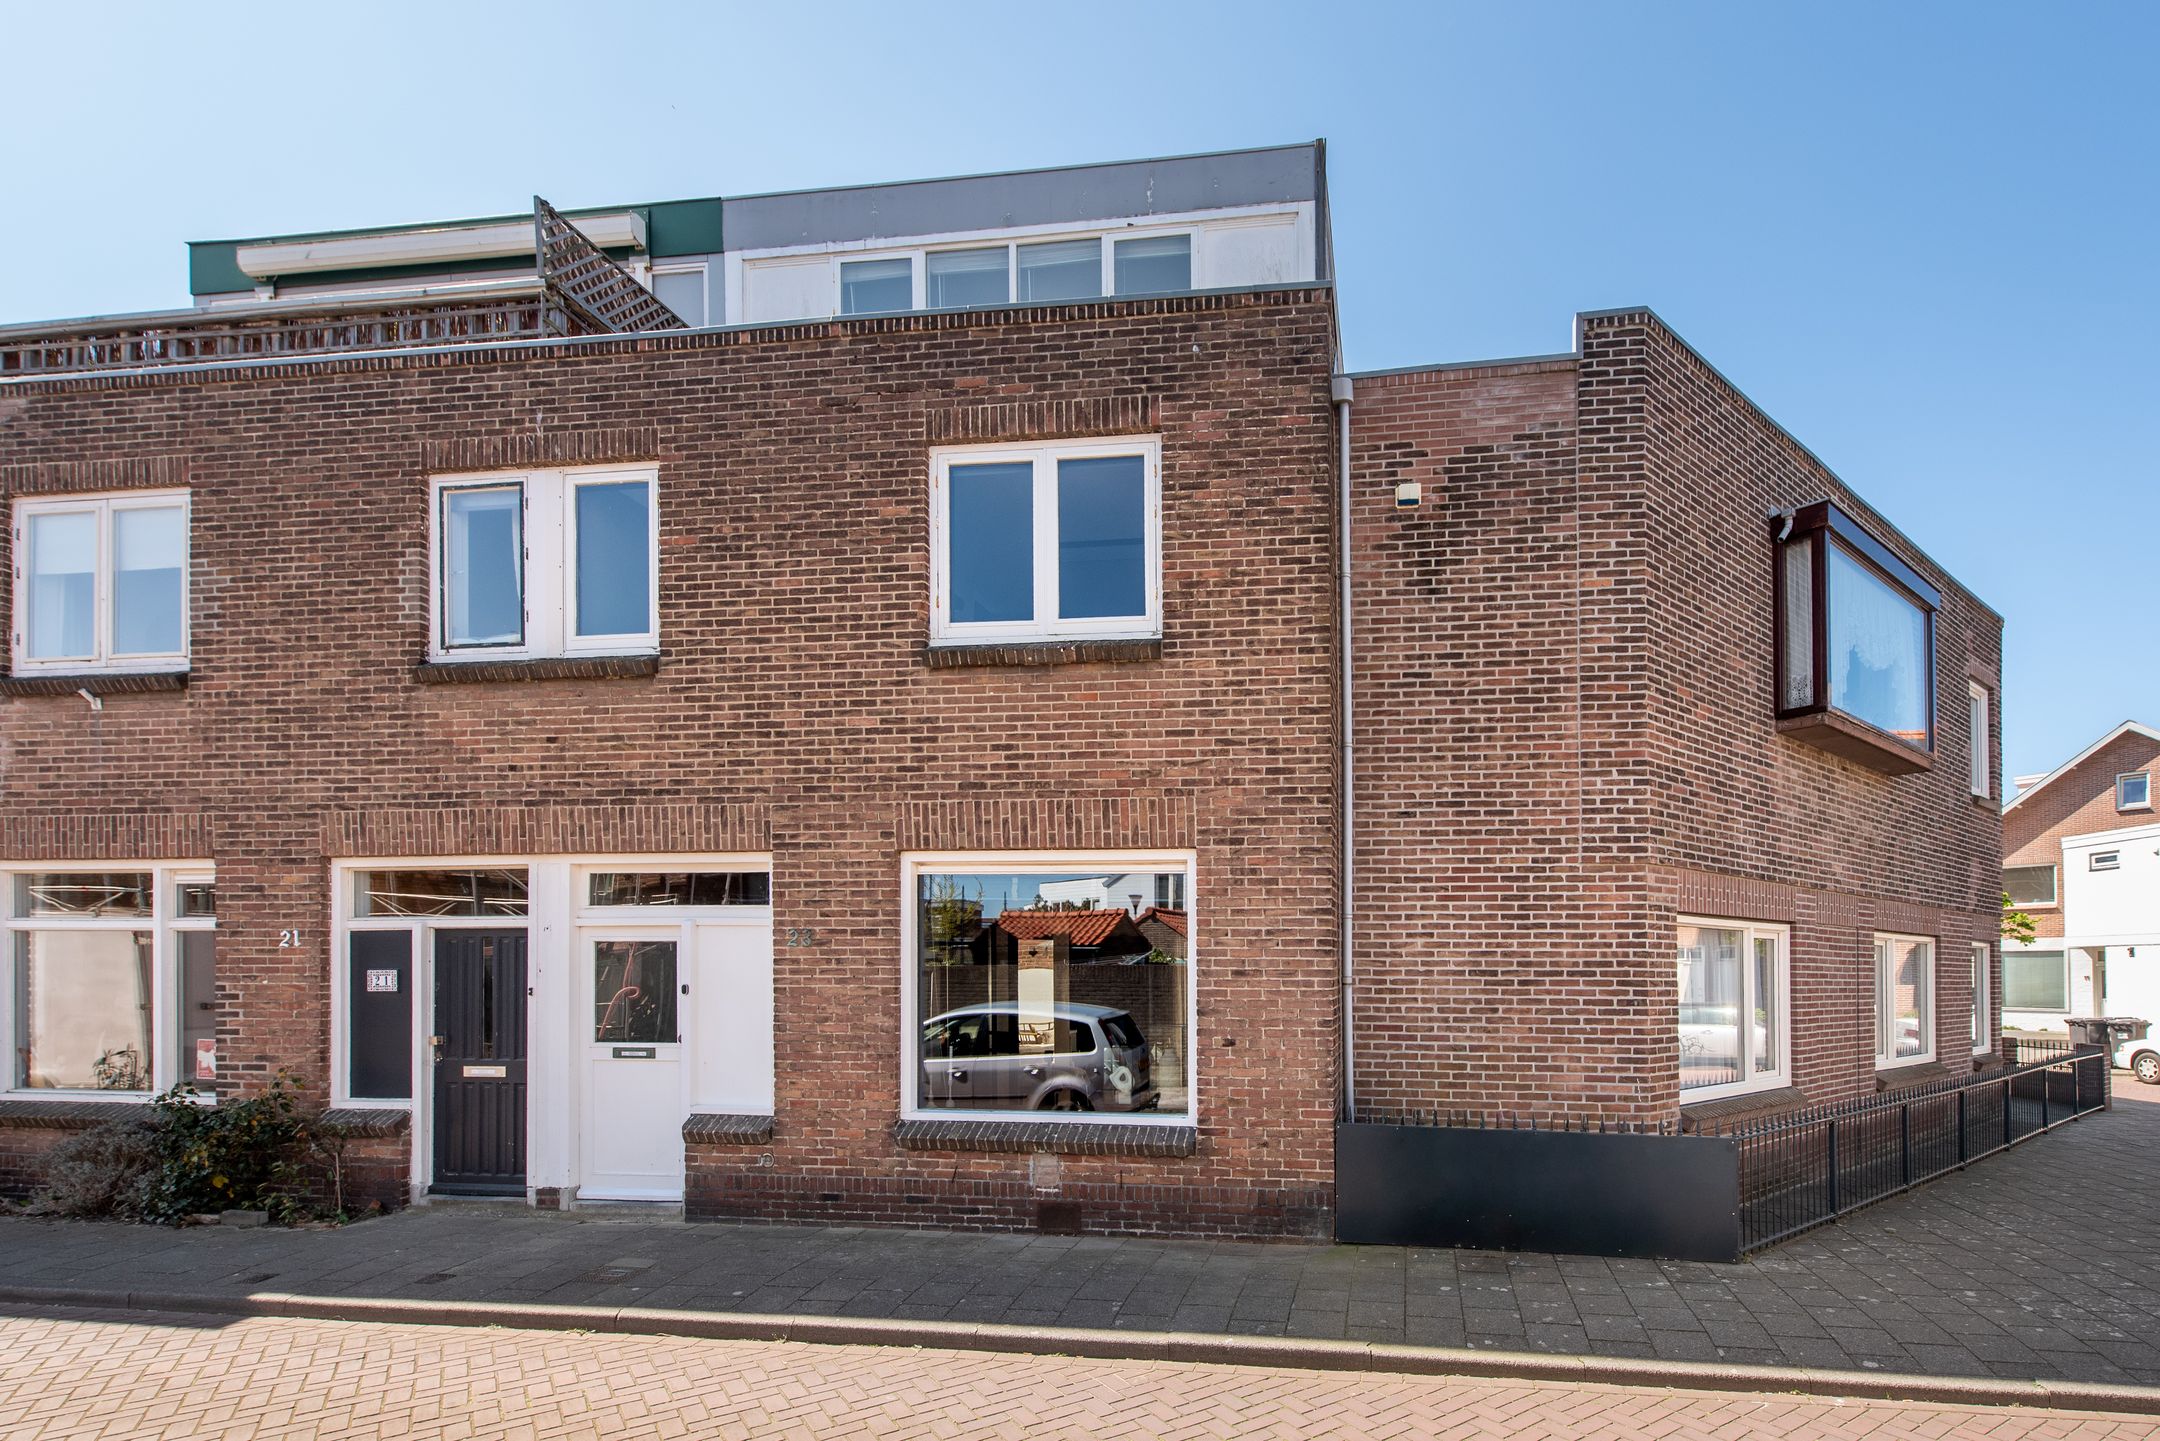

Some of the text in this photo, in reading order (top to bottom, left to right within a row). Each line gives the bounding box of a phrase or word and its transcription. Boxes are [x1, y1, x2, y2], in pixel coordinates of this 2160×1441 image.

[279, 929, 301, 947] 21
[787, 928, 812, 947] 23
[374, 976, 388, 986] 21
